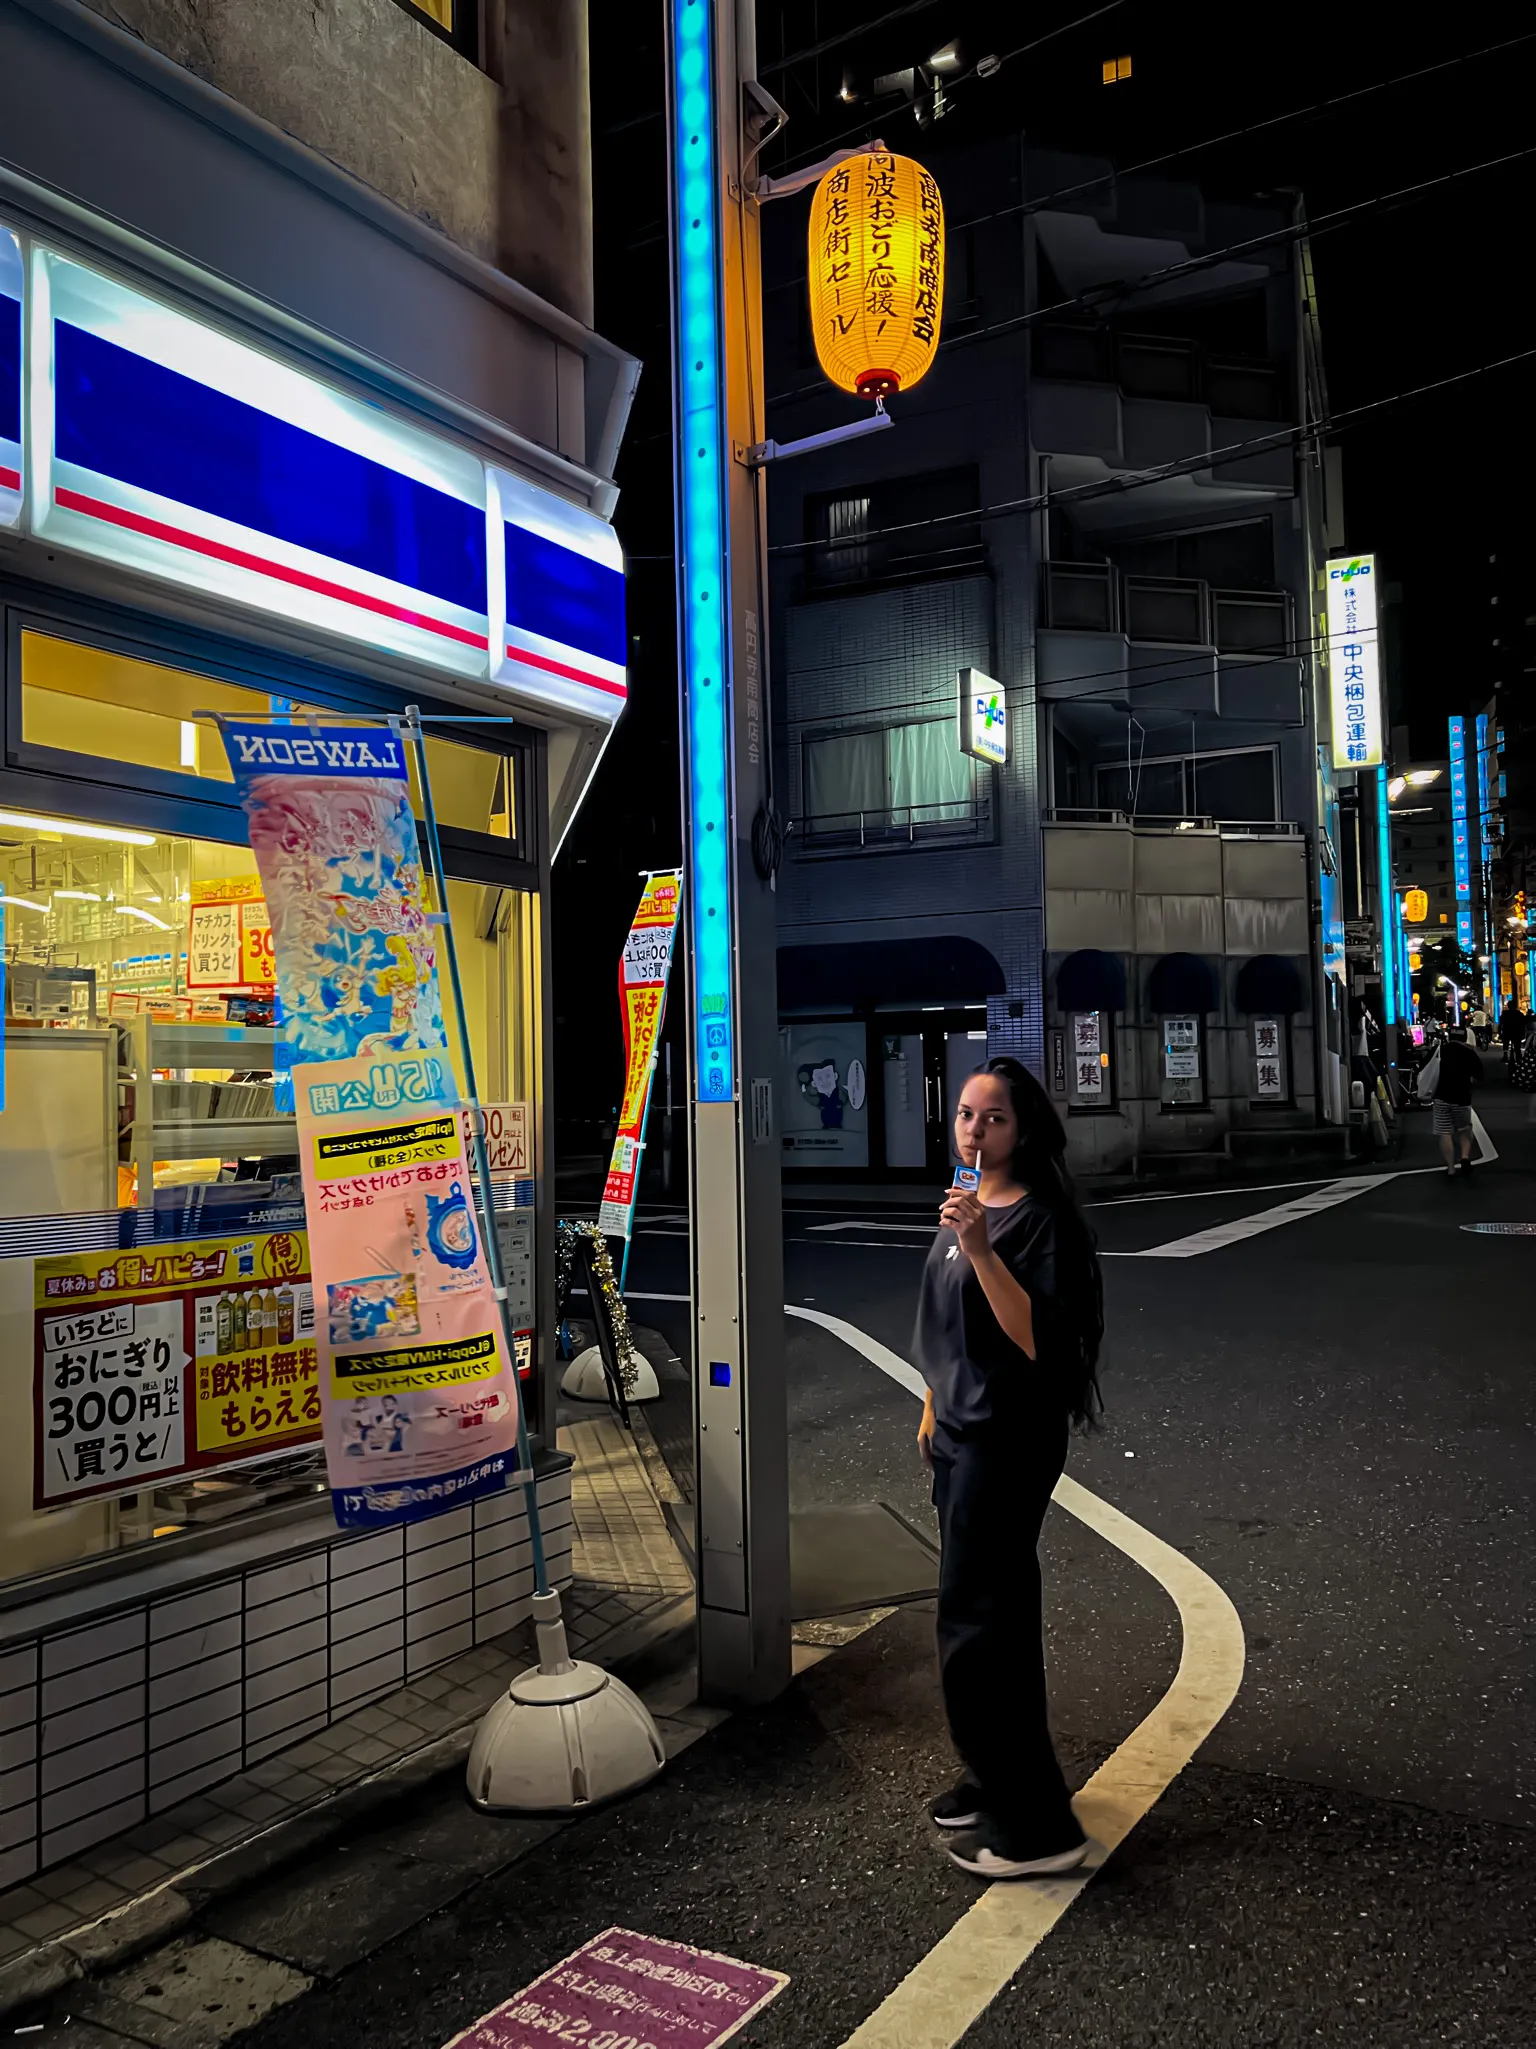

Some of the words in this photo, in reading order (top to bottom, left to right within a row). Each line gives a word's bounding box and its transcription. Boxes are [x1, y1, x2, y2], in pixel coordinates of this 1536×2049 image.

[824, 168, 860, 343] 商店街セール
[1330, 564, 1371, 581] CHUO
[1344, 587, 1358, 635] 株式会社
[1343, 643, 1367, 763] 中央梱包運輸
[193, 932, 231, 949] ドリンク
[198, 952, 232, 973] 買うと
[1256, 1027, 1279, 1087] 募集
[53, 1313, 128, 1347] いちどに
[54, 1337, 171, 1389] おにぎり
[221, 1384, 321, 1437] もらえる
[73, 1431, 158, 1482] 買うと
